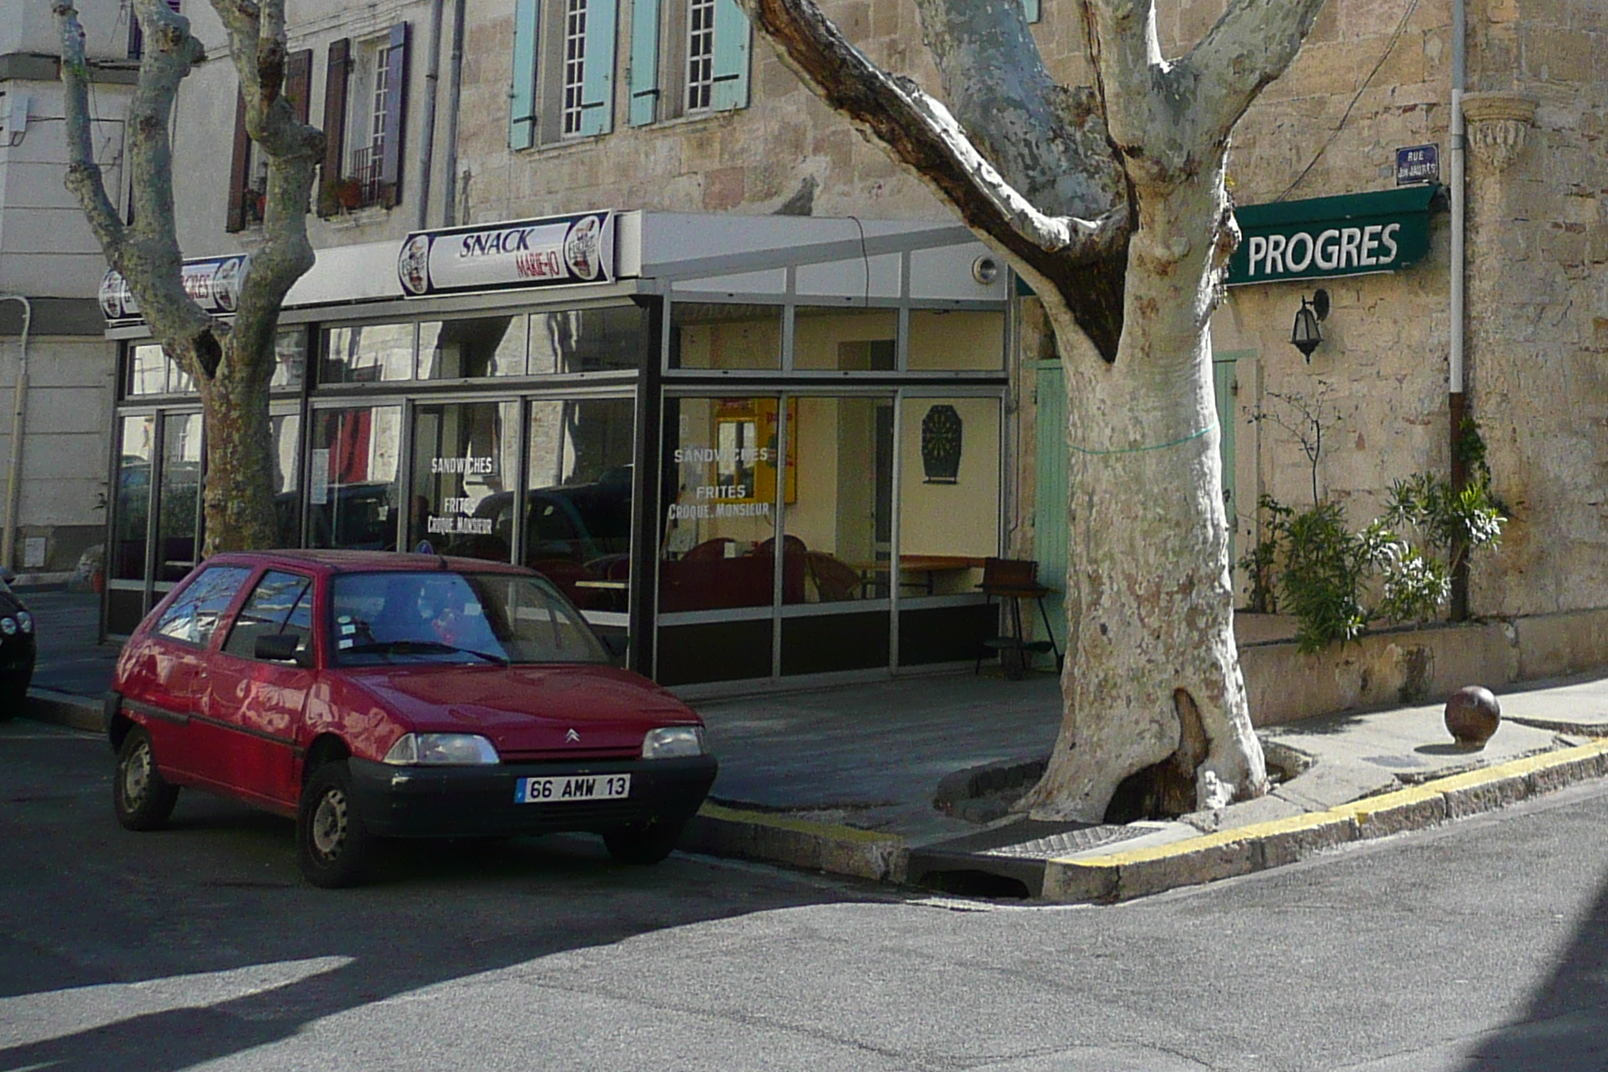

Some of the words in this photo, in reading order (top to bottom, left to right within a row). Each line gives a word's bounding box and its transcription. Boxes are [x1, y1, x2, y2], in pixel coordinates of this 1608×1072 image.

[1407, 150, 1424, 162] RUE
[459, 228, 536, 258] SNACK
[1248, 223, 1401, 276] PROGRES
[674, 447, 768, 463] SANDWICHES
[431, 457, 492, 474] SANDWICHES
[696, 485, 746, 499] FRITES
[444, 496, 476, 513] FRITES
[530, 779, 553, 799] 66
[561, 778, 597, 798] AMW
[606, 777, 626, 796] 13
